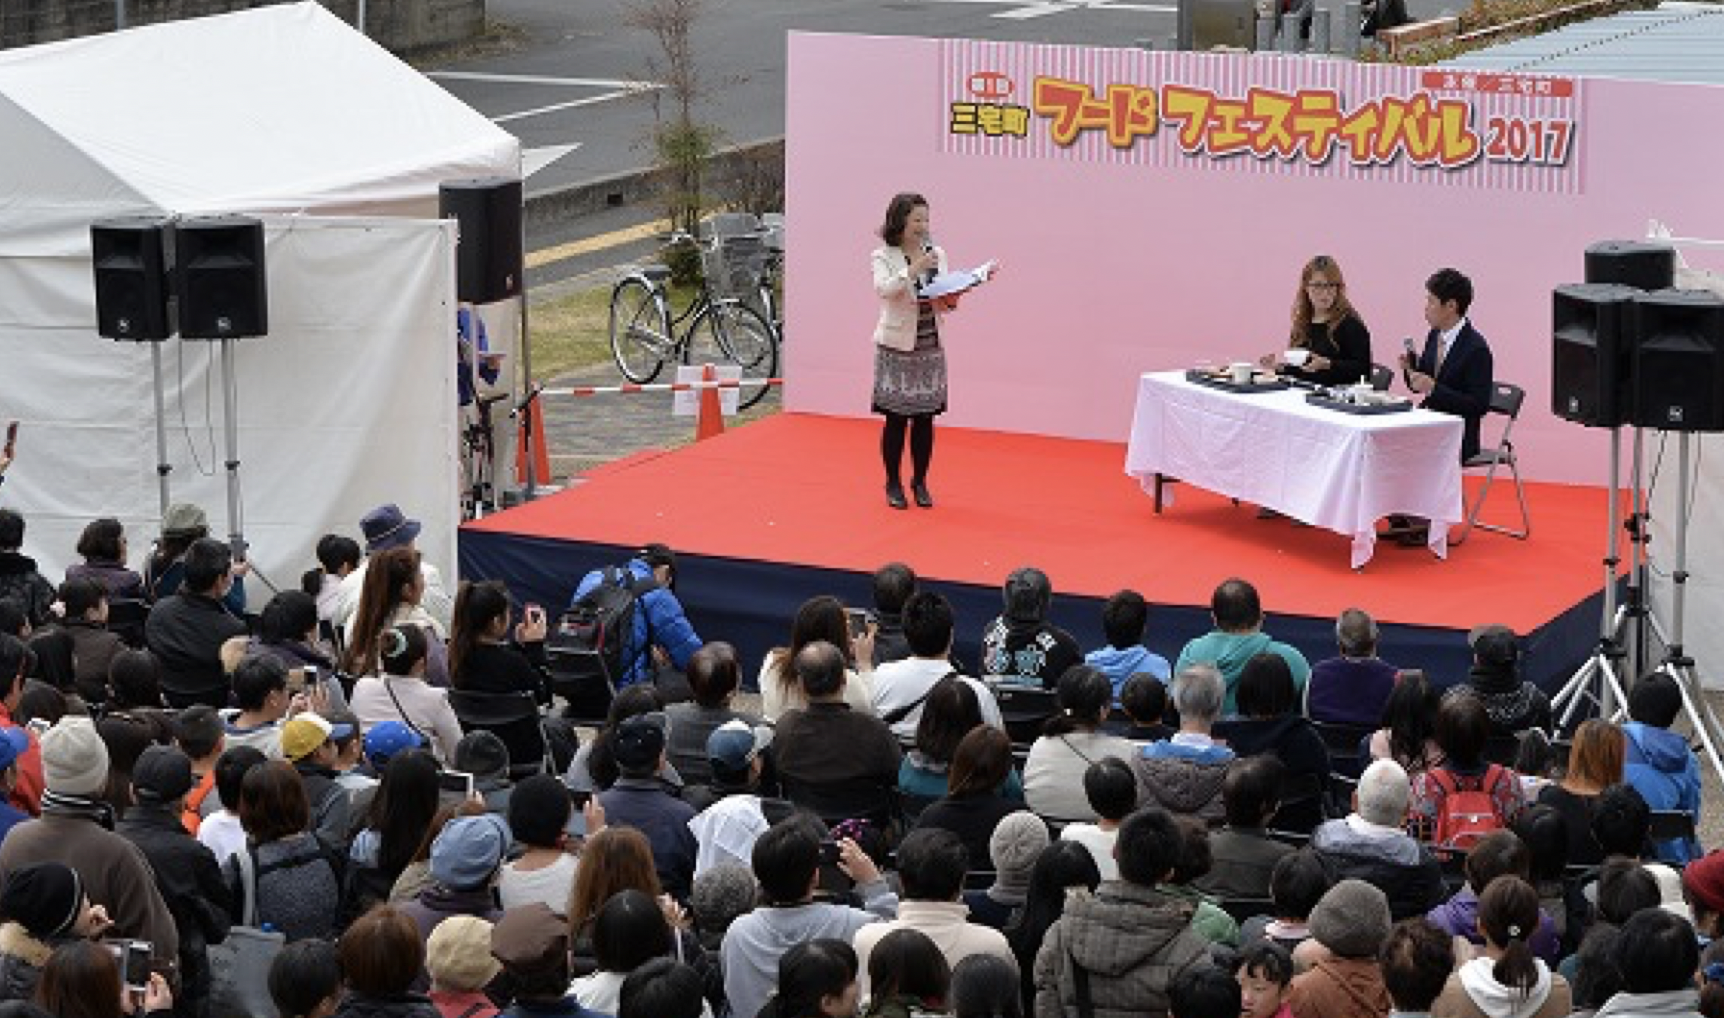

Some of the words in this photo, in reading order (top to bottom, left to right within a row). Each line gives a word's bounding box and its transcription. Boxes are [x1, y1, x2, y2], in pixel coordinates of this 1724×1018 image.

[951, 103, 1030, 137] 三宅町
[1034, 77, 1158, 148] フード
[1162, 84, 1480, 168] フェスティバル
[1486, 116, 1573, 166] 2017
